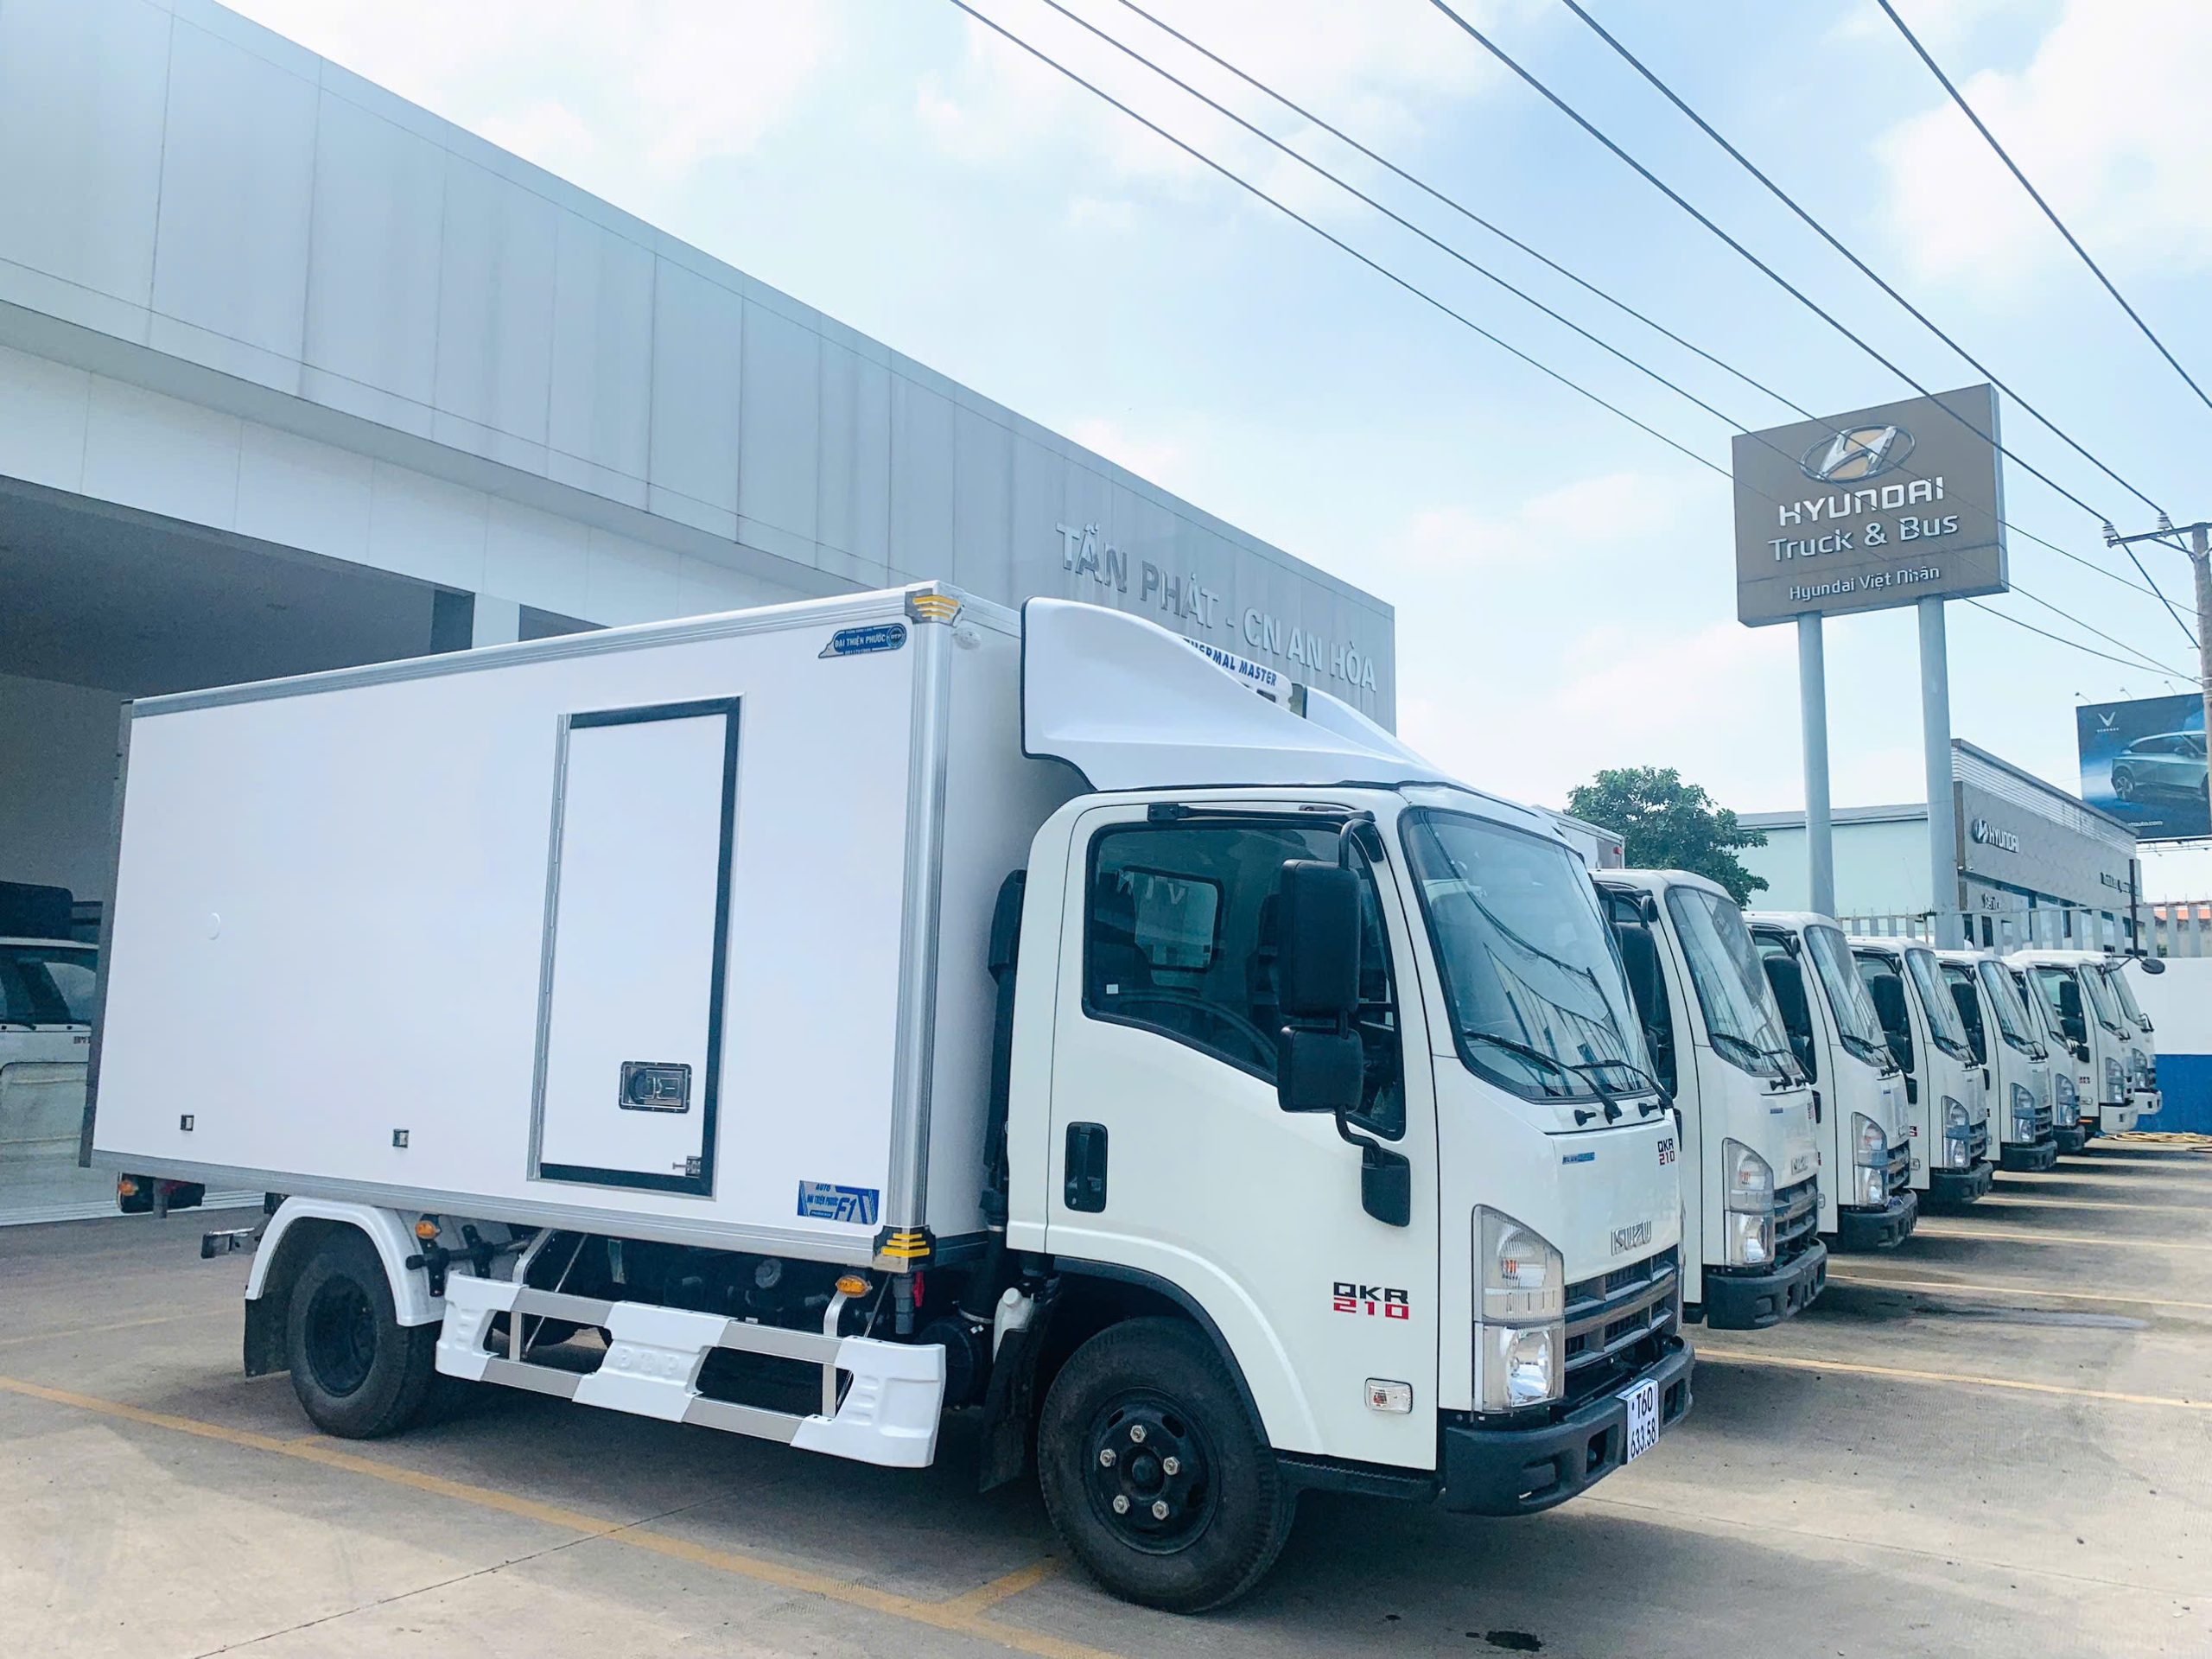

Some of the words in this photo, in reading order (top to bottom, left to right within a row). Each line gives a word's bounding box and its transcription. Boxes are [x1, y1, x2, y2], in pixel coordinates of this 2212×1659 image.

[1779, 476, 1944, 526] HYUNDAI
[1768, 529, 1854, 561] Truck
[1864, 522, 1887, 547] &
[1901, 514, 1959, 541] Bus
[1790, 578, 1855, 601] Hyundai
[1859, 571, 1891, 591] Việt
[1897, 566, 1941, 585] Nhân
[1141, 560, 1219, 629] PHÁT
[1243, 607, 1281, 655] CN
[1286, 626, 1322, 671] AN
[1330, 640, 1376, 692] HÒA
[1183, 638, 1236, 671] ERMAL
[1238, 660, 1277, 686] MASTER
[1989, 825, 2019, 853] HYUNDAI
[1657, 1138, 1675, 1153] QKR
[1659, 1151, 1675, 1166] 210
[816, 1183, 831, 1192] AUTO
[1611, 1219, 1652, 1256] ISUZU
[1333, 1281, 1409, 1305] QKR
[1333, 1297, 1409, 1320] 210
[1630, 1417, 1656, 1459] 633.58
